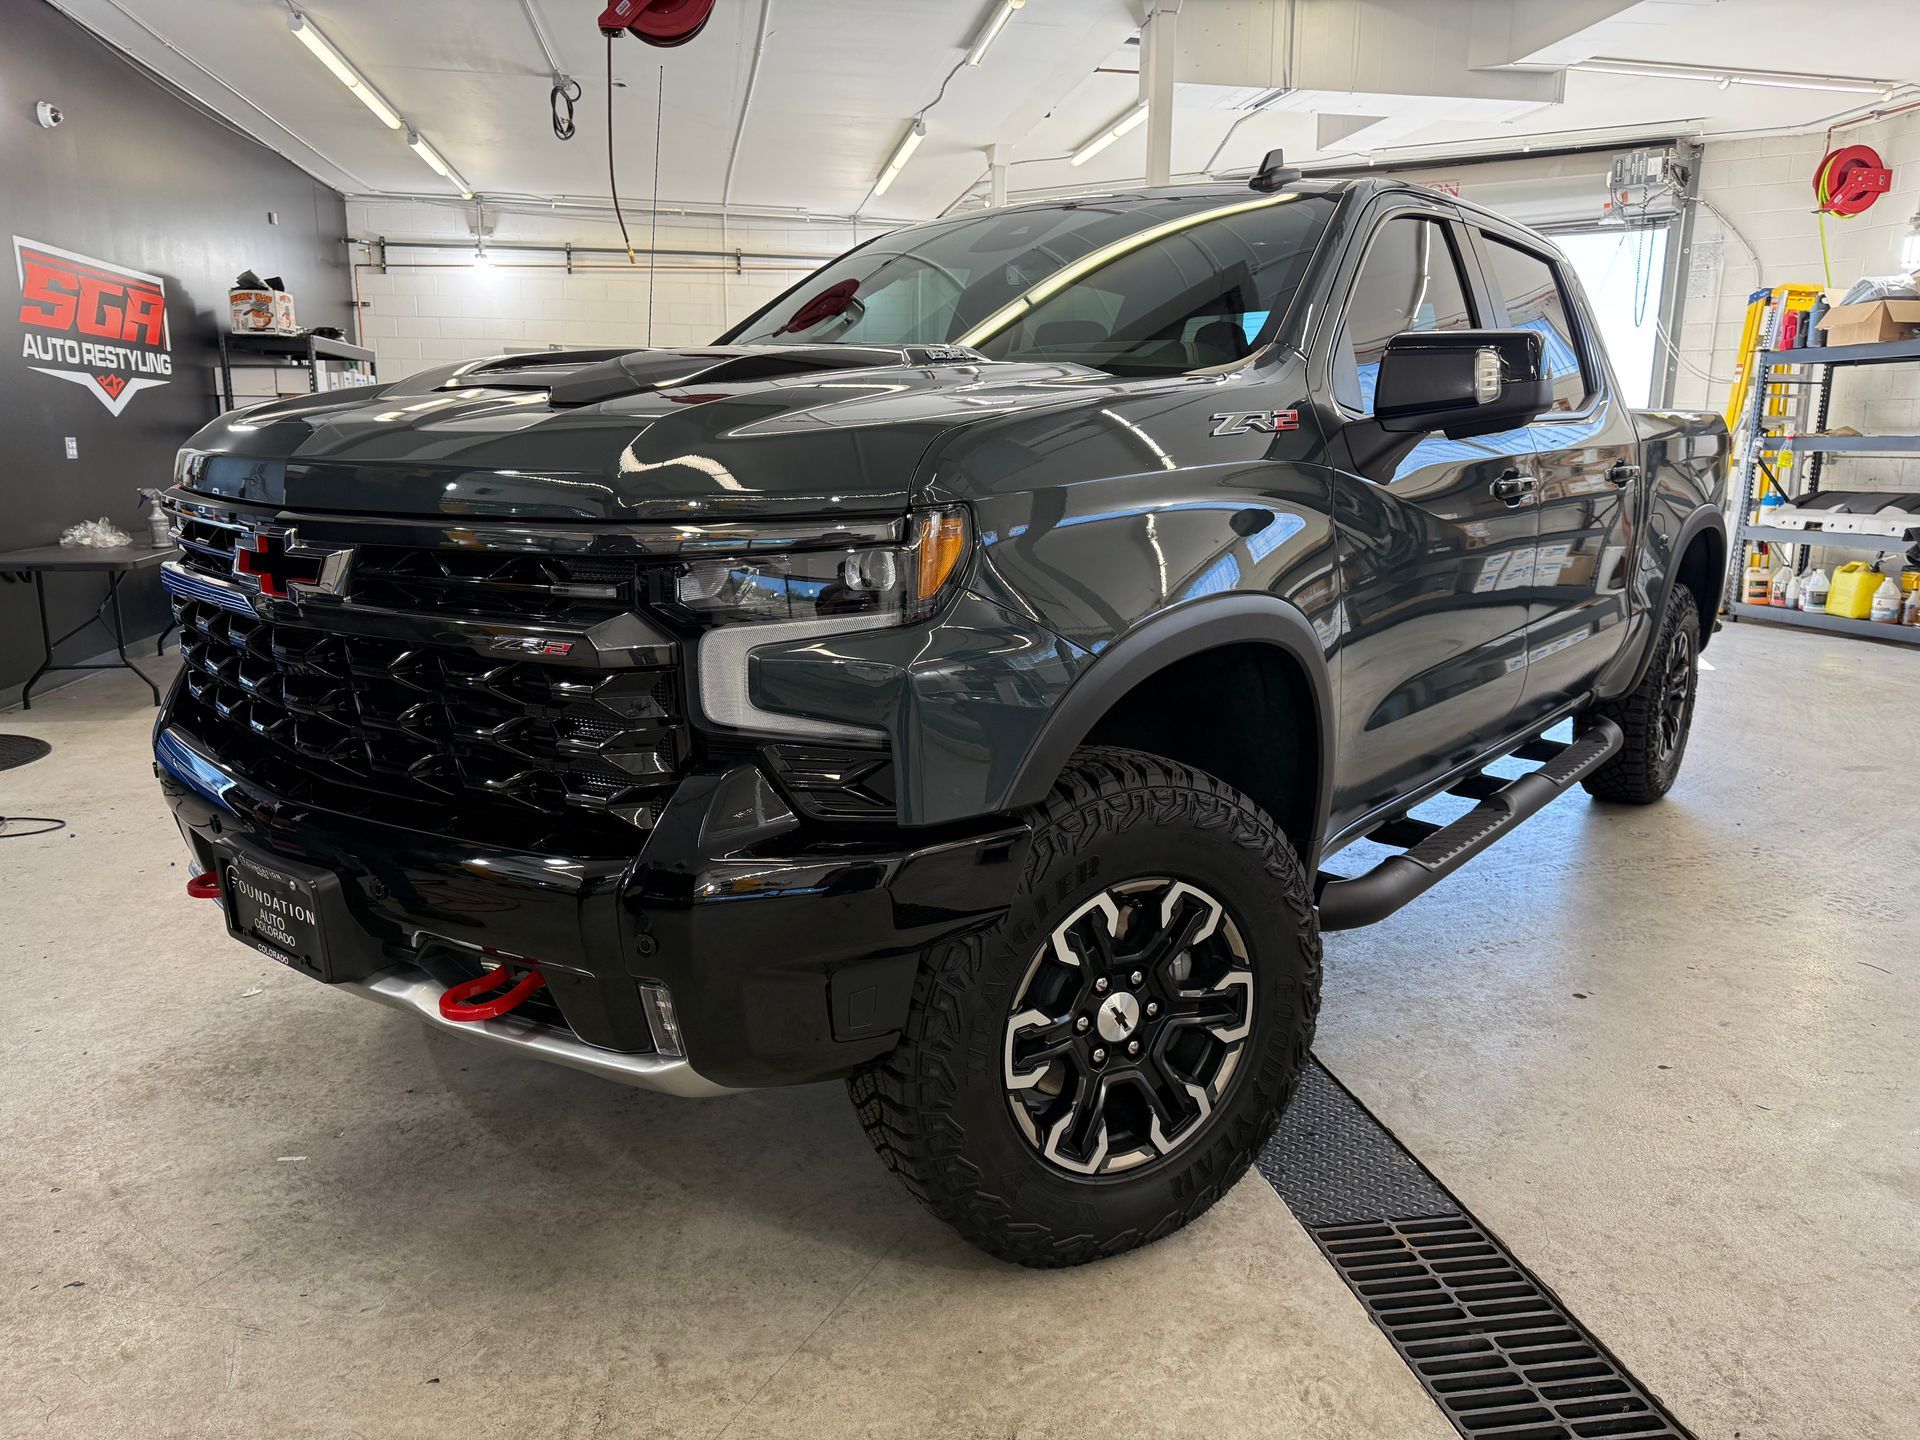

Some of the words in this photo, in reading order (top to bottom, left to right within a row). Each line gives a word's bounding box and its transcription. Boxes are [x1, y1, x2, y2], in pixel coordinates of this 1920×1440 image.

[19, 260, 164, 346] SGA
[22, 333, 81, 364] AUTO
[81, 341, 173, 375] RESTYLING
[1209, 409, 1300, 438] ZR2
[489, 634, 576, 657] ZR2
[254, 919, 296, 946] COLORADO
[259, 908, 285, 931] AUTO
[257, 944, 289, 964] COLORADO
[966, 854, 1101, 1087] WRANGLER
